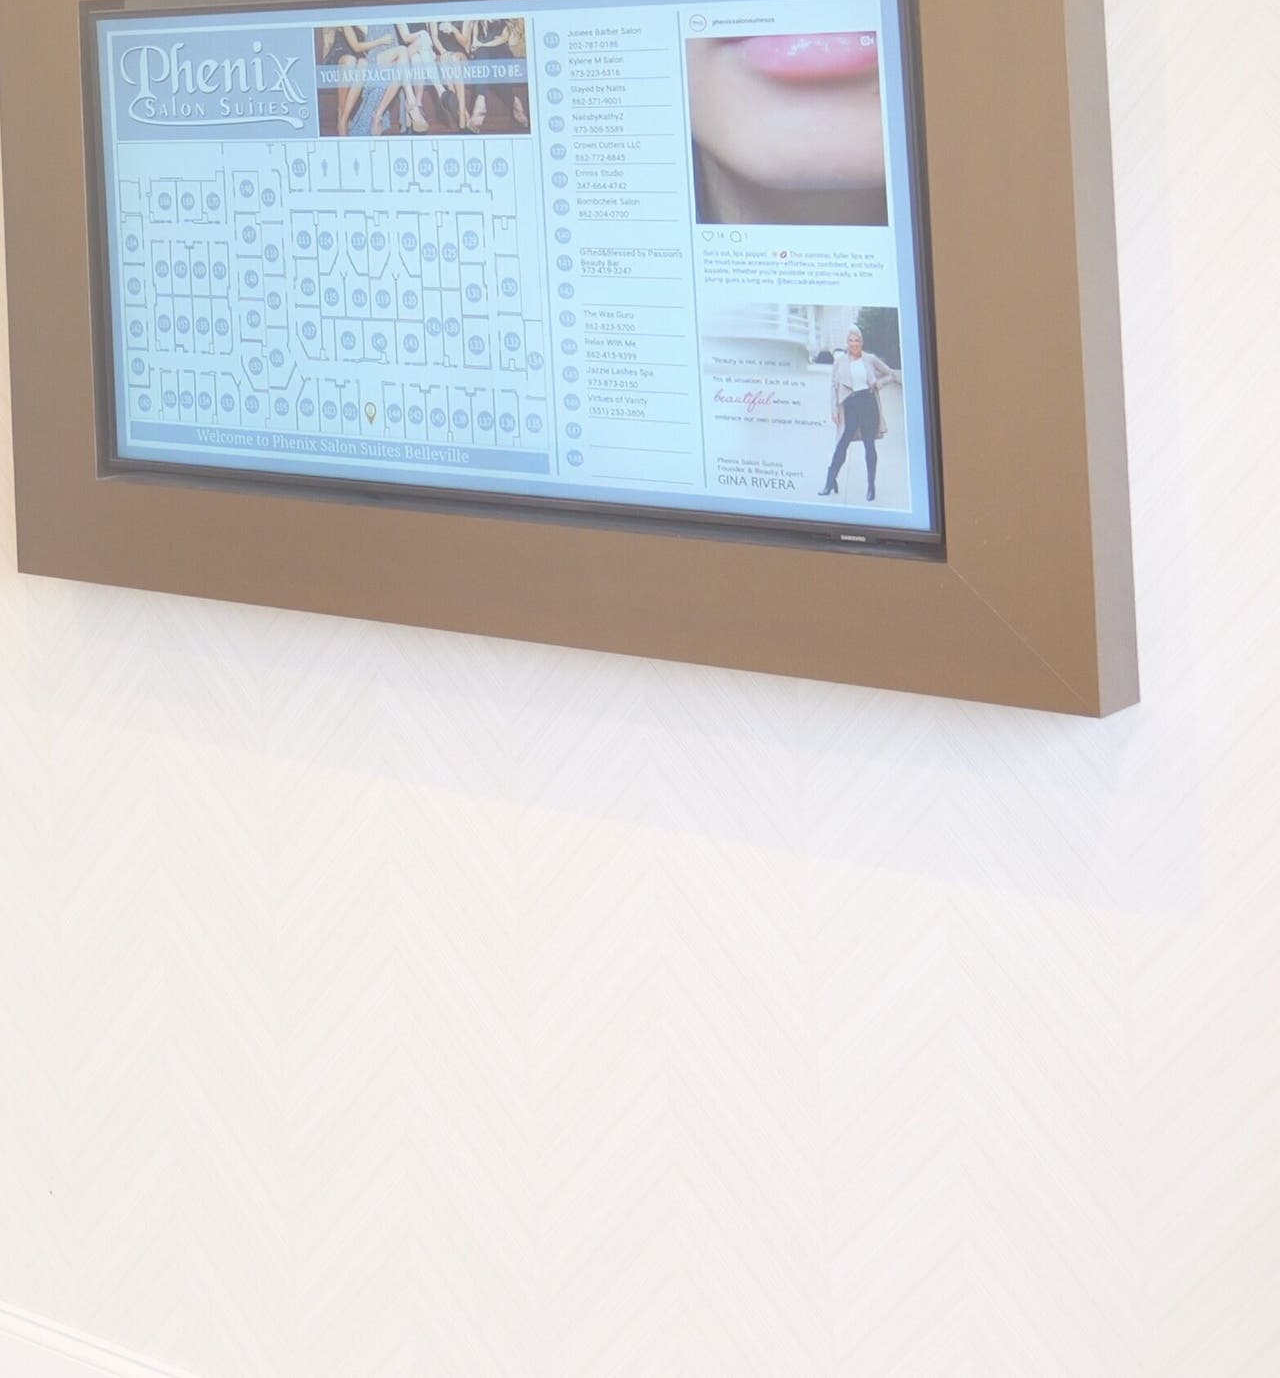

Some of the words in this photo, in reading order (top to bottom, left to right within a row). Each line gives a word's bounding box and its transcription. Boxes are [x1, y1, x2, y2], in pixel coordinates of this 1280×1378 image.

[618, 26, 642, 35] Salon
[603, 55, 624, 64] Salon
[120, 41, 309, 103] Phenix
[320, 70, 337, 83] YOU
[341, 68, 361, 83] ARE
[362, 68, 402, 82] EXACTLY
[405, 67, 439, 81] WHERE
[440, 67, 463, 80] YOU
[464, 67, 489, 79] NEED
[493, 66, 507, 78] TO
[627, 140, 641, 149] LLC
[618, 197, 641, 206] Salon
[584, 310, 596, 318] The
[640, 369, 654, 378] Spa
[713, 388, 775, 413] beautiful
[196, 428, 253, 446] Welcome
[255, 432, 269, 447] to
[272, 433, 316, 452] Phenix
[320, 437, 358, 454] Salon
[361, 440, 400, 458] Suites
[404, 444, 469, 463] Belleville
[718, 474, 747, 486] GINA
[751, 476, 796, 490] RIVERA
